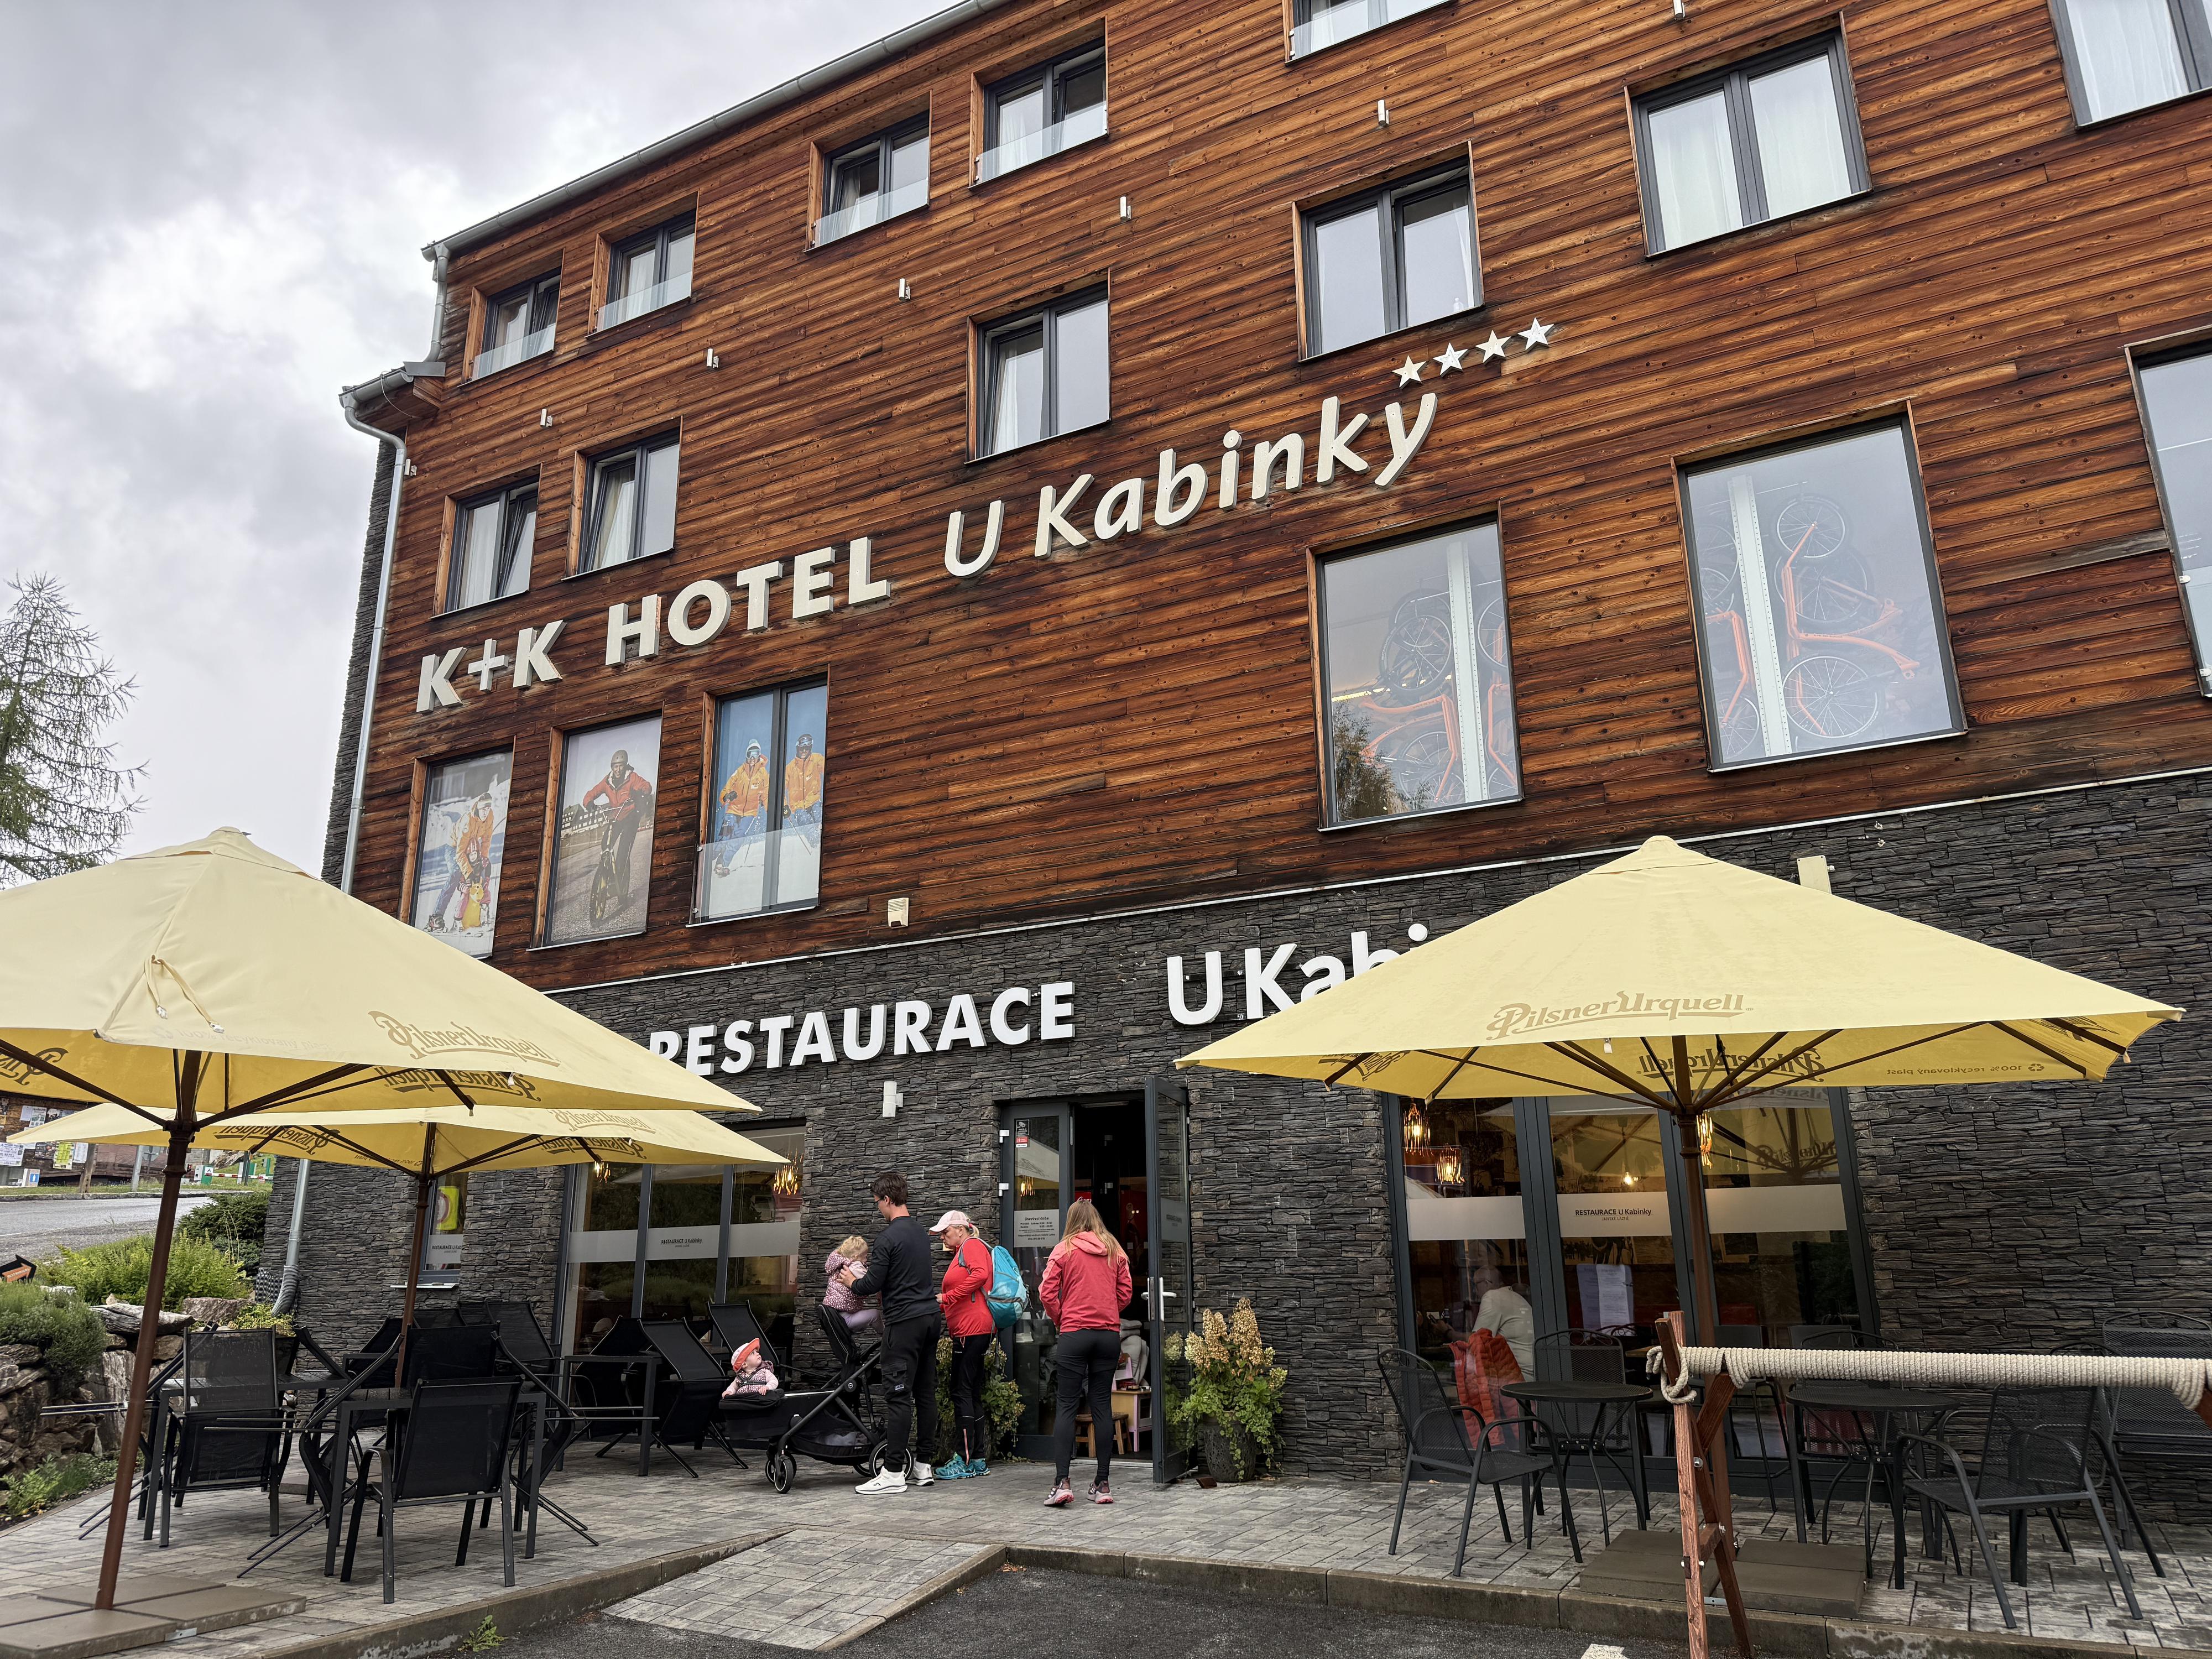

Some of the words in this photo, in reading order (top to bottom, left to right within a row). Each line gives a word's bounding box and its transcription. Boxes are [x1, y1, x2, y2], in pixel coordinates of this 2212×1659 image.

[416, 619, 567, 713] K+K
[604, 536, 891, 666] HOTEL
[943, 499, 1004, 579] U
[1033, 392, 1438, 560] Kabinky
[368, 1010, 472, 1060] Pilsner
[451, 1021, 552, 1062] Urquell
[649, 982, 1075, 1076] RESTAURACE
[1167, 951, 1223, 1026] U
[1486, 1000, 1618, 1041] Pilsner
[1616, 990, 1744, 1021] Urquell
